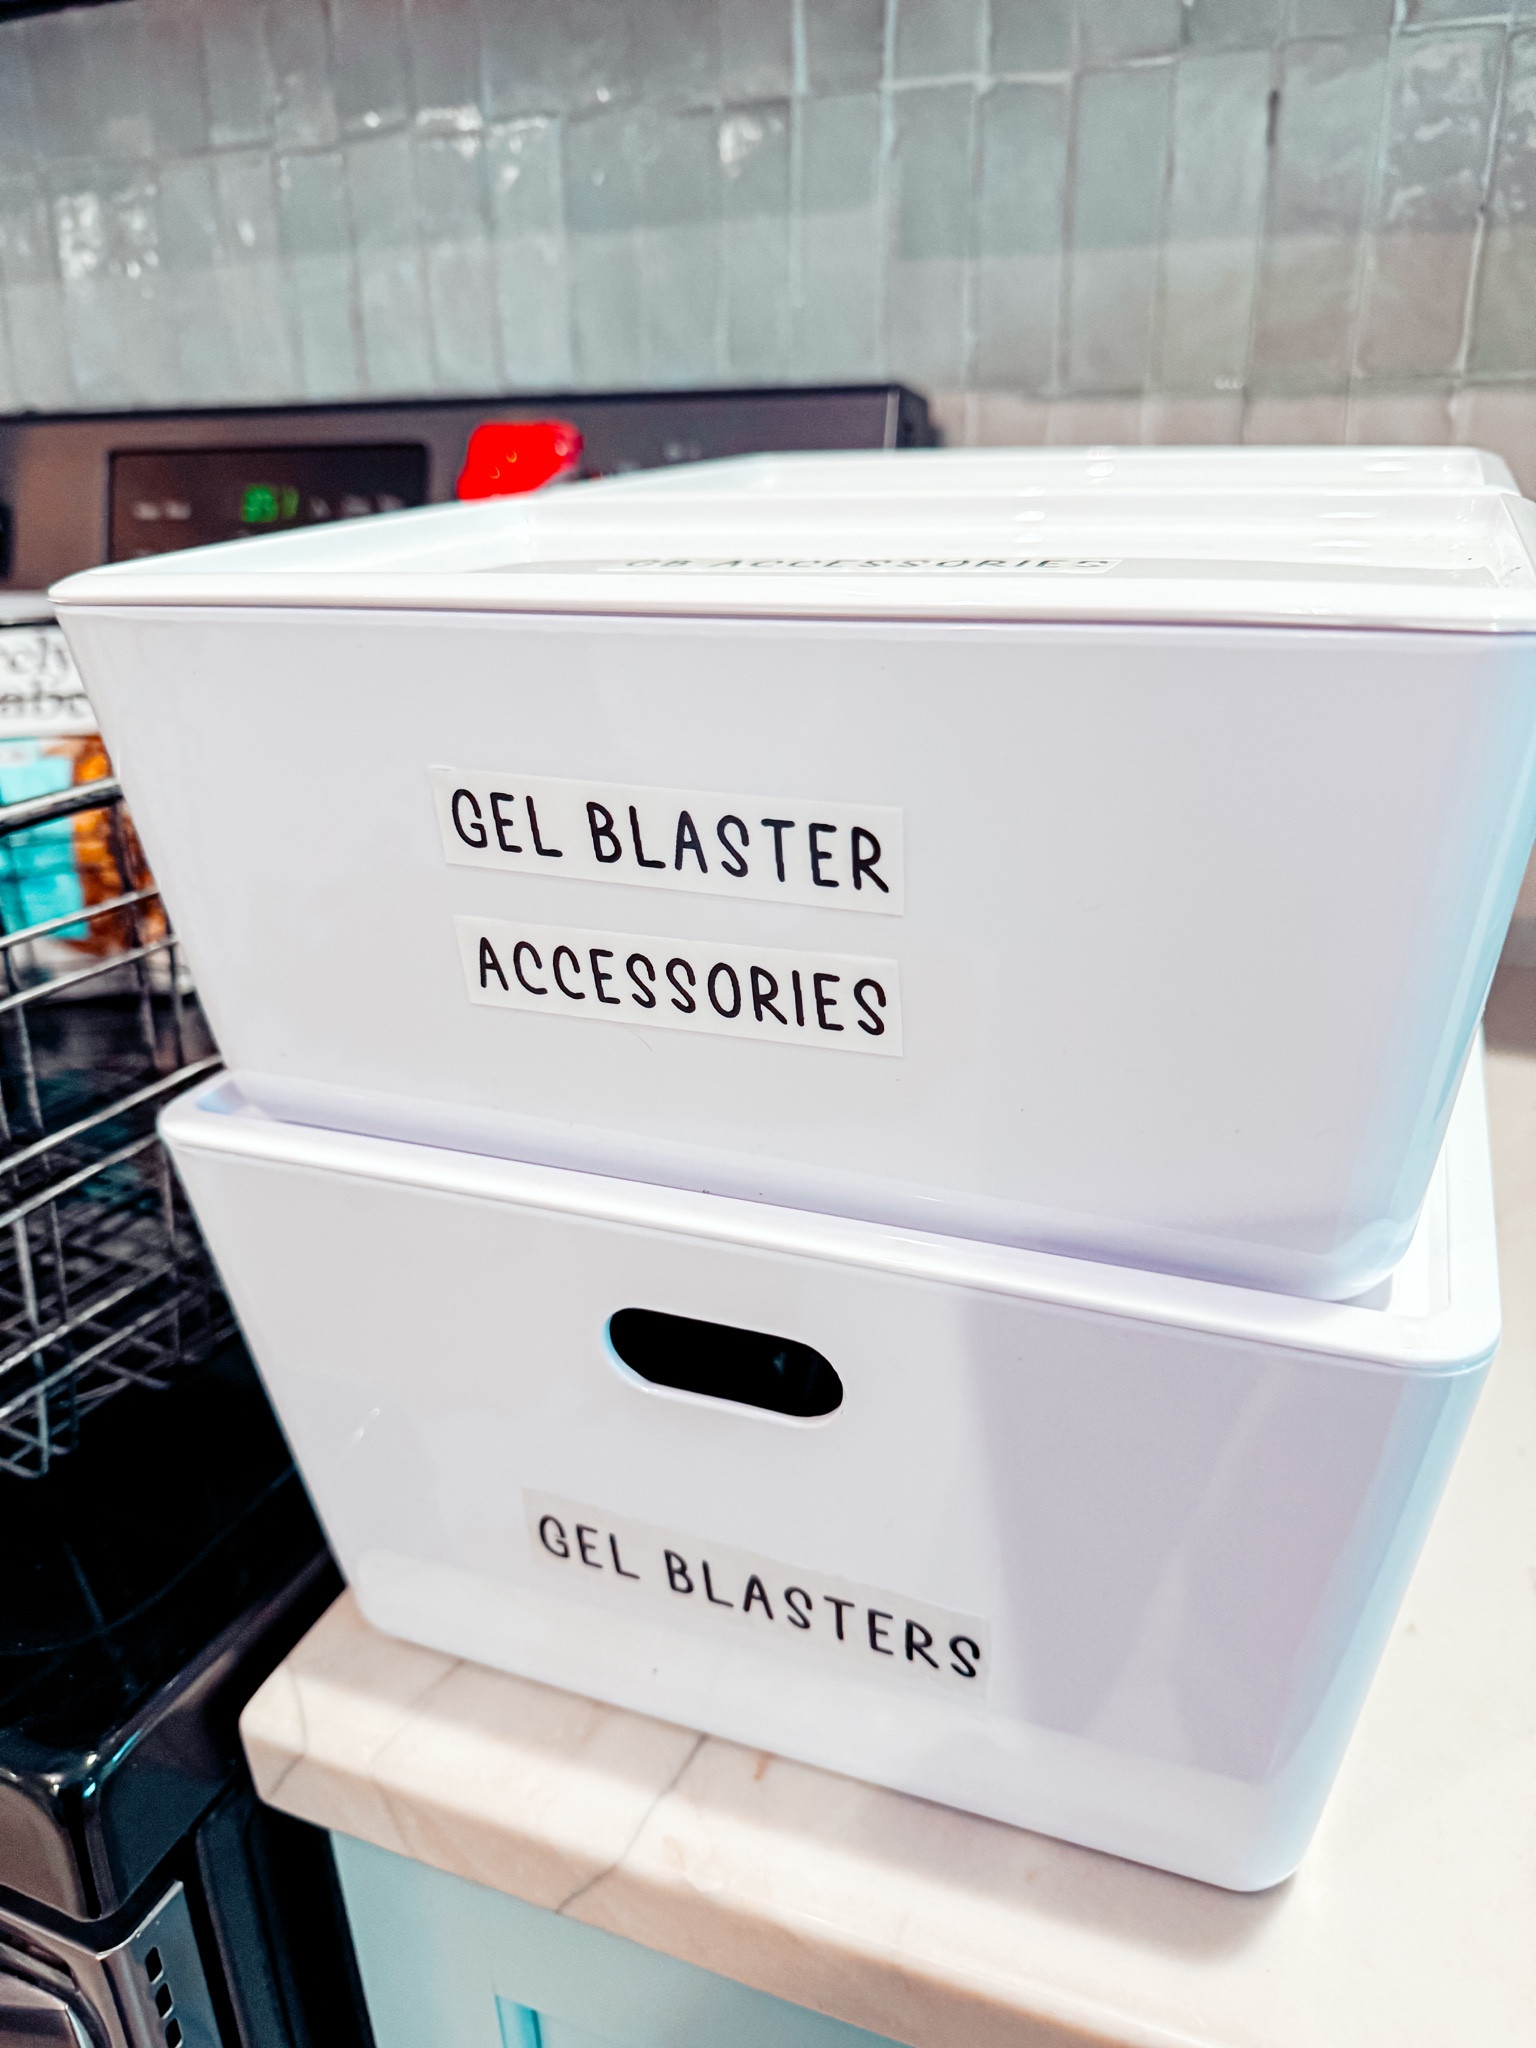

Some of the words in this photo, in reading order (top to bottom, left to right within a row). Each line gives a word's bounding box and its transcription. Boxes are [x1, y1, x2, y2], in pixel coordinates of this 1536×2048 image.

[708, 559, 1109, 569] ACCESSORIES
[450, 787, 565, 859] GEL
[584, 800, 891, 895] BLASTER
[478, 935, 888, 1037] ACCESSORIES
[538, 1514, 641, 1581] GEL
[663, 1549, 982, 1680] BLASTERS
